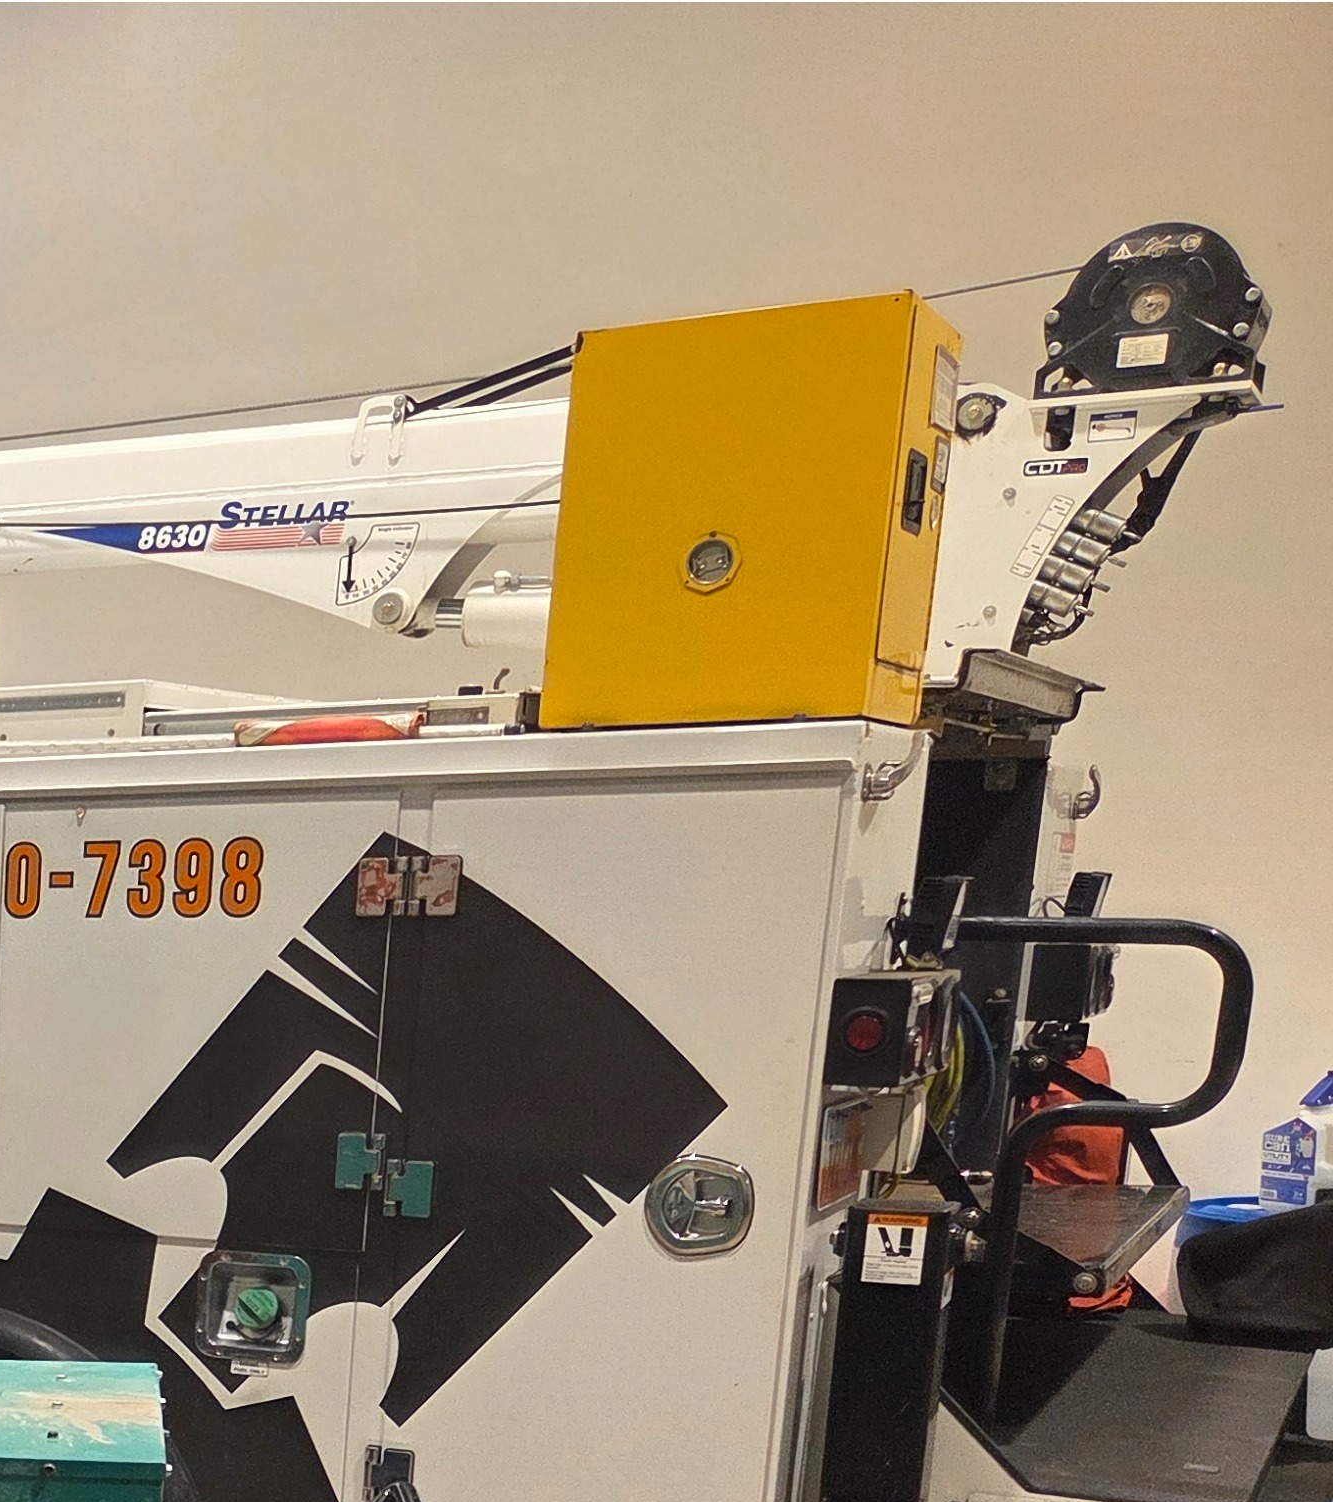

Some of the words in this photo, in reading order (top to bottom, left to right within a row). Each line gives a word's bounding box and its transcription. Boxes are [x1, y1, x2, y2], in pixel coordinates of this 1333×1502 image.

[220, 500, 350, 528] STELLAR
[138, 524, 207, 550] 8630
[1264, 1134, 1291, 1144] SURE
[1262, 1152, 1289, 1160] UTILITY
